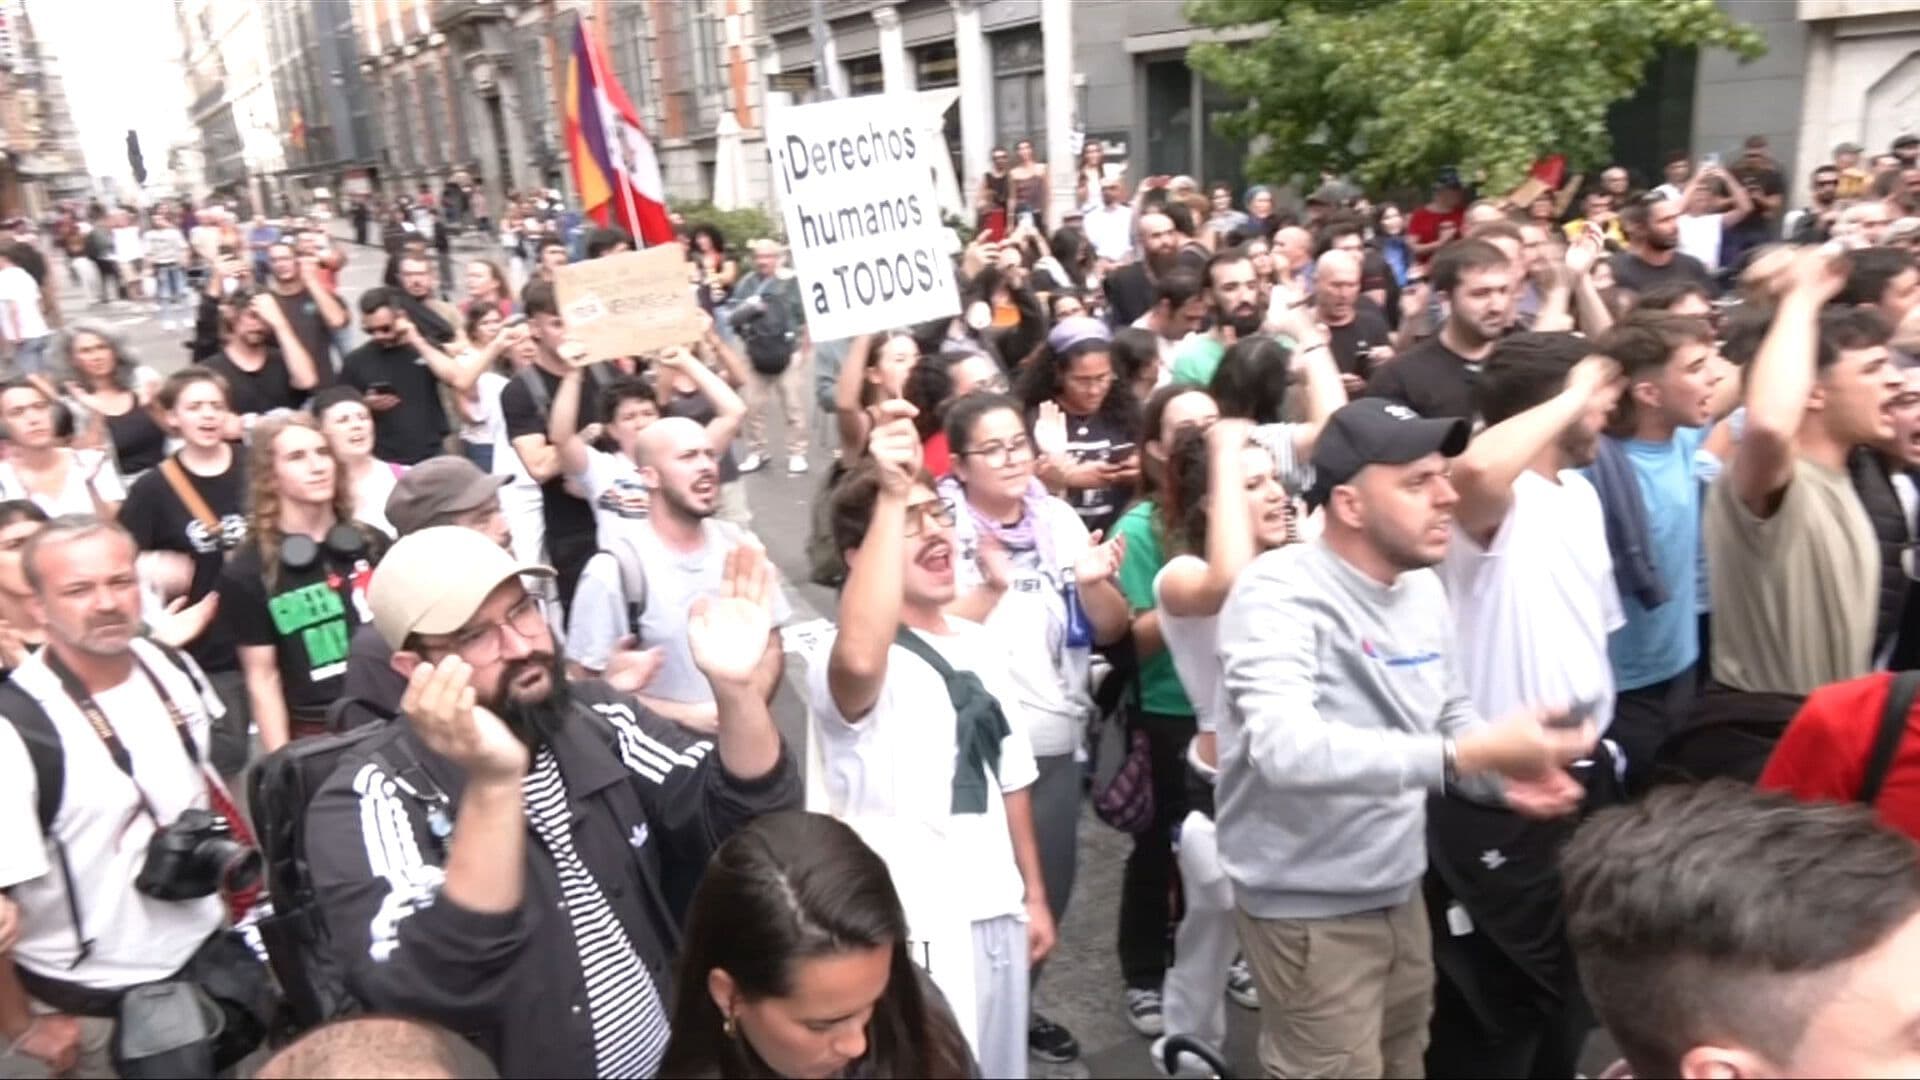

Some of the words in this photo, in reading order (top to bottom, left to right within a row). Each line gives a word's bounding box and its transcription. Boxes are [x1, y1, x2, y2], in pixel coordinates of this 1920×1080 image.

[779, 122, 916, 195] ¡Derechos
[797, 194, 923, 249] humanos
[812, 281, 831, 315] a
[832, 247, 944, 310] TODOS!
